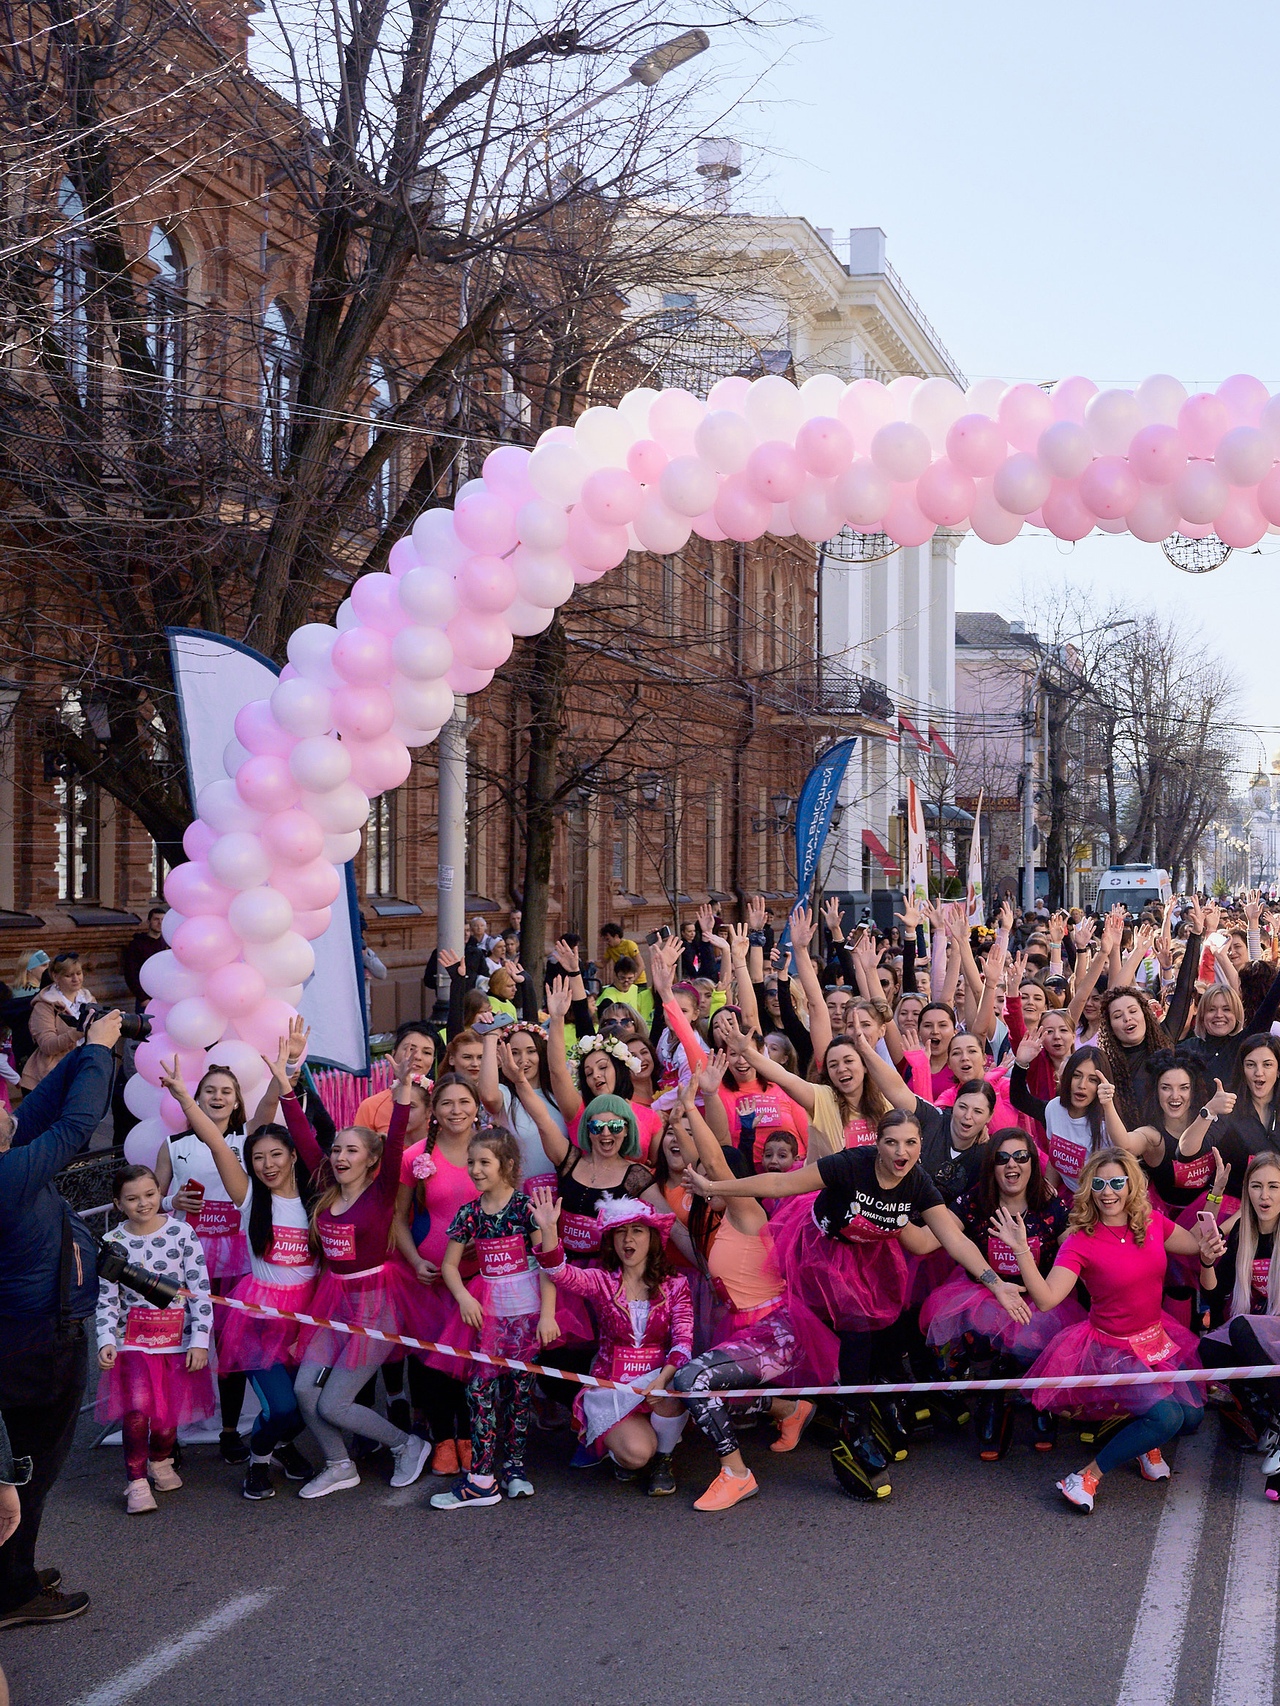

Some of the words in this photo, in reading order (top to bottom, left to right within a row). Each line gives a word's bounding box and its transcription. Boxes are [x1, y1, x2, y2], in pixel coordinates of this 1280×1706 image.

[1052, 1149, 1080, 1167] ОКСАНА
[1187, 1166, 1211, 1179] АННА
[856, 1190, 875, 1206] YOU
[875, 1201, 897, 1212] CAN
[898, 1202, 912, 1212] BE
[199, 1213, 227, 1223] НИКА
[861, 1209, 896, 1224] WHATEVER
[563, 1225, 592, 1240] ЕЛЕНА
[273, 1240, 309, 1253] АЛИНА
[484, 1251, 512, 1263] АГАТА
[993, 1251, 1018, 1262] ТАТЬ
[624, 1362, 652, 1371] ИННА
